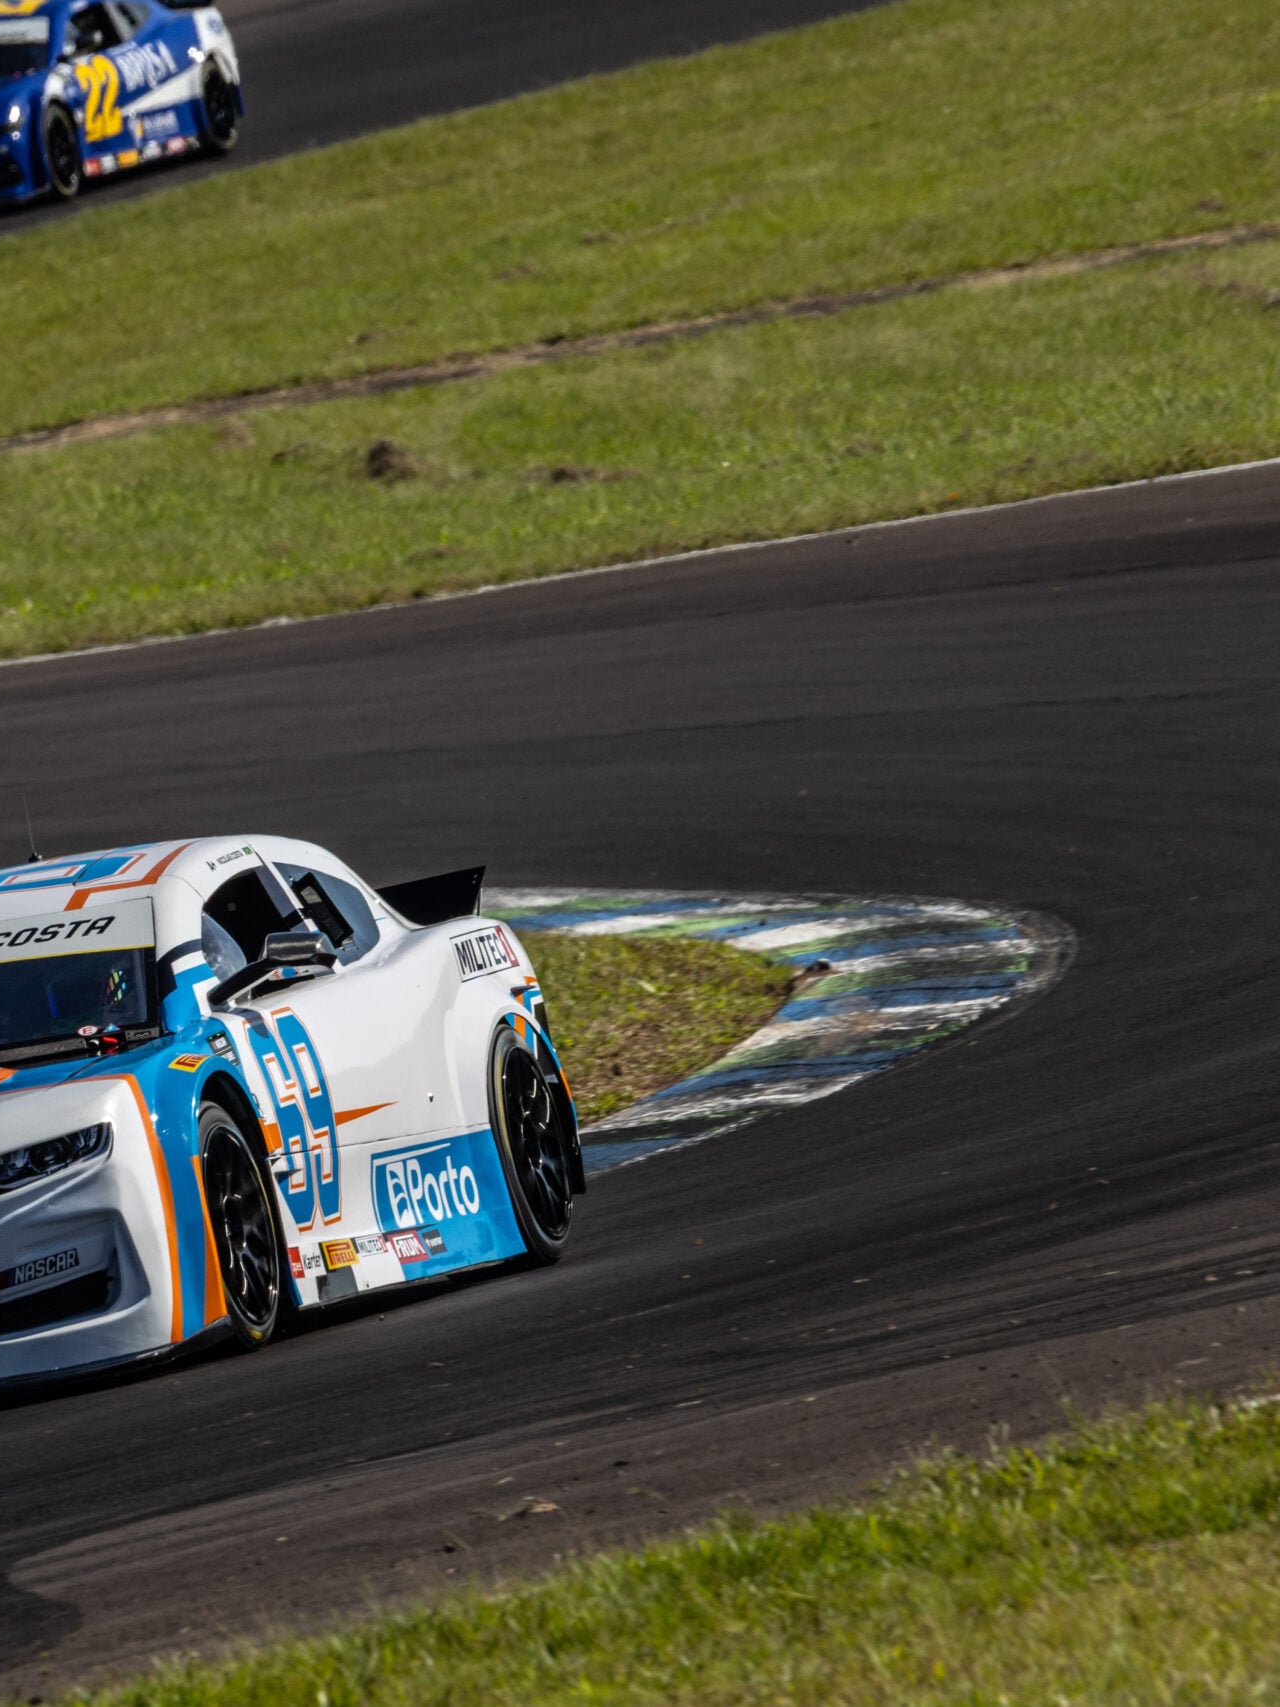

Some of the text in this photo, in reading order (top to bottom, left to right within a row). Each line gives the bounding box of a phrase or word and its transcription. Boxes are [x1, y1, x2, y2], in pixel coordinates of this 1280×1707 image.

[74, 54, 123, 145] 22
[243, 1006, 342, 1234] 69
[406, 1155, 480, 1225] Porto
[14, 1250, 77, 1285] NASCAR
[326, 1242, 356, 1266] PIRELLI
